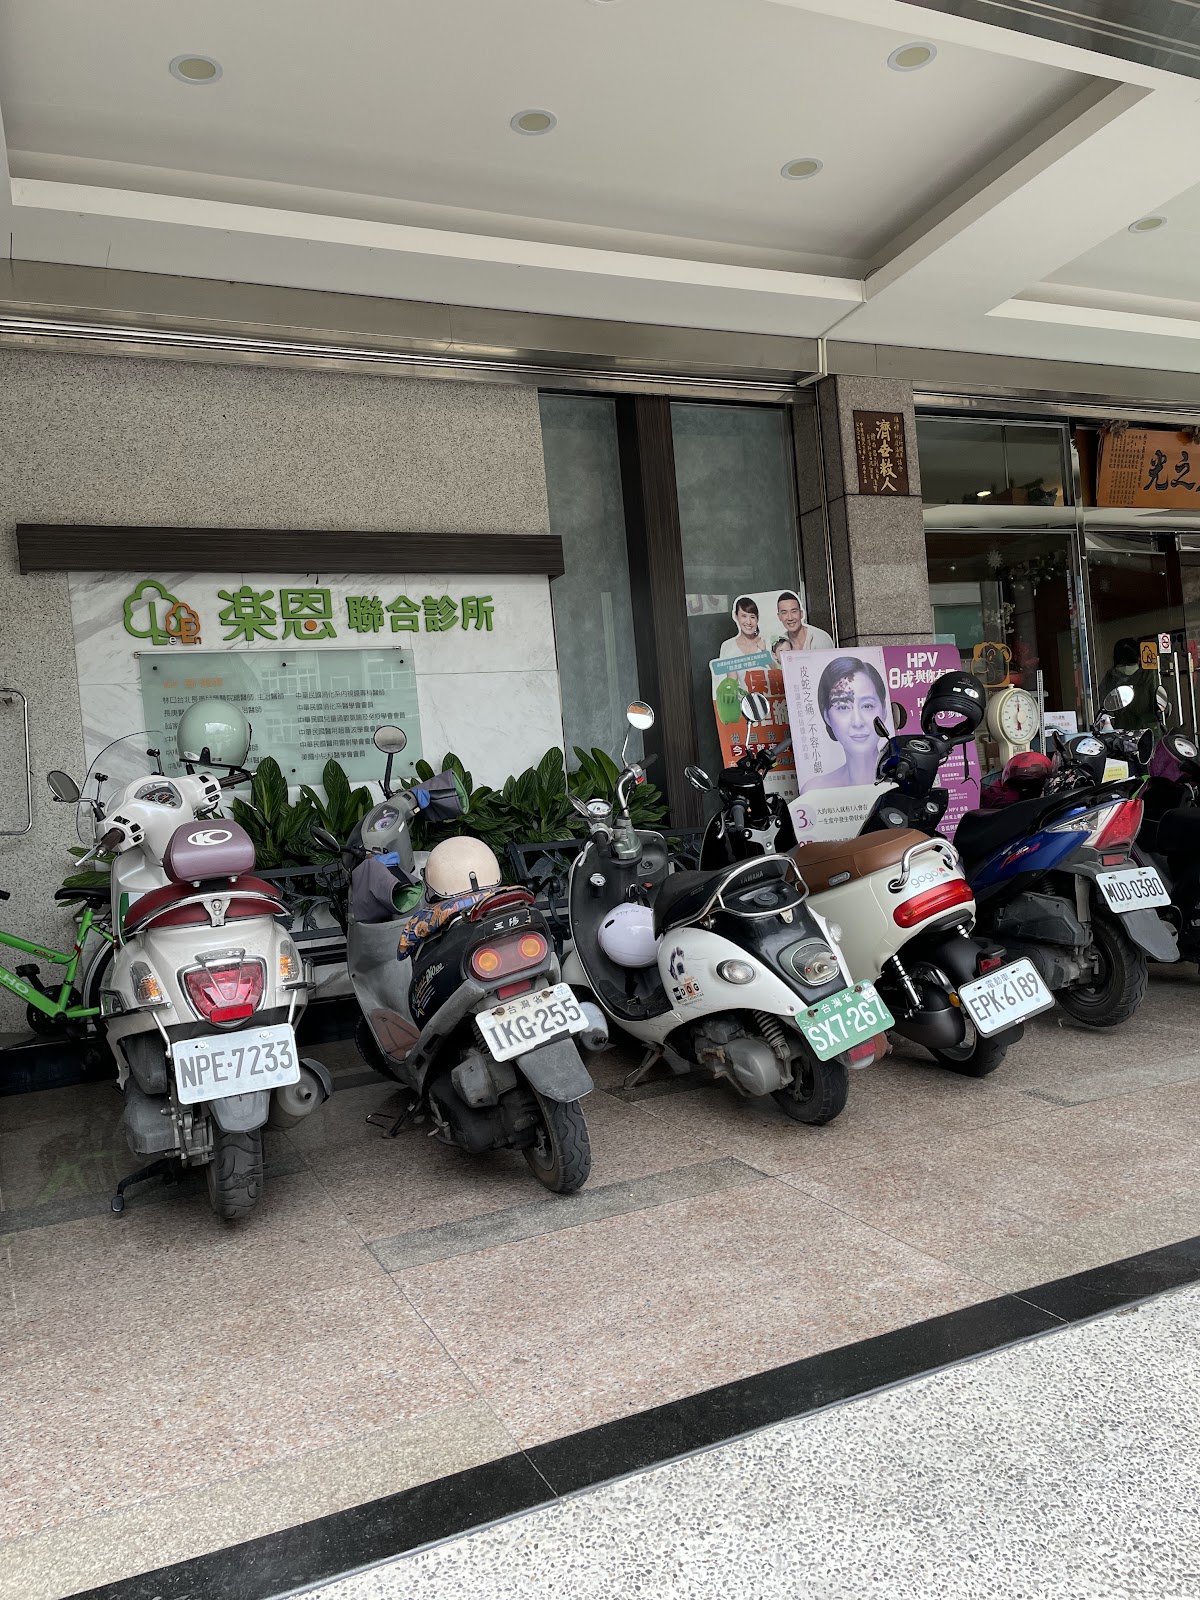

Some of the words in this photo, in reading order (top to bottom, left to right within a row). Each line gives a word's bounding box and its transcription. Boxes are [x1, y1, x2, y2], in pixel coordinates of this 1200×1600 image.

[876, 418, 898, 492] 濟世救人
[346, 595, 495, 632] 聯合診所
[906, 651, 938, 668] HPV
[740, 870, 764, 884] YAMAHA
[493, 916, 520, 931] 三陽
[507, 994, 544, 1015] 台灣省
